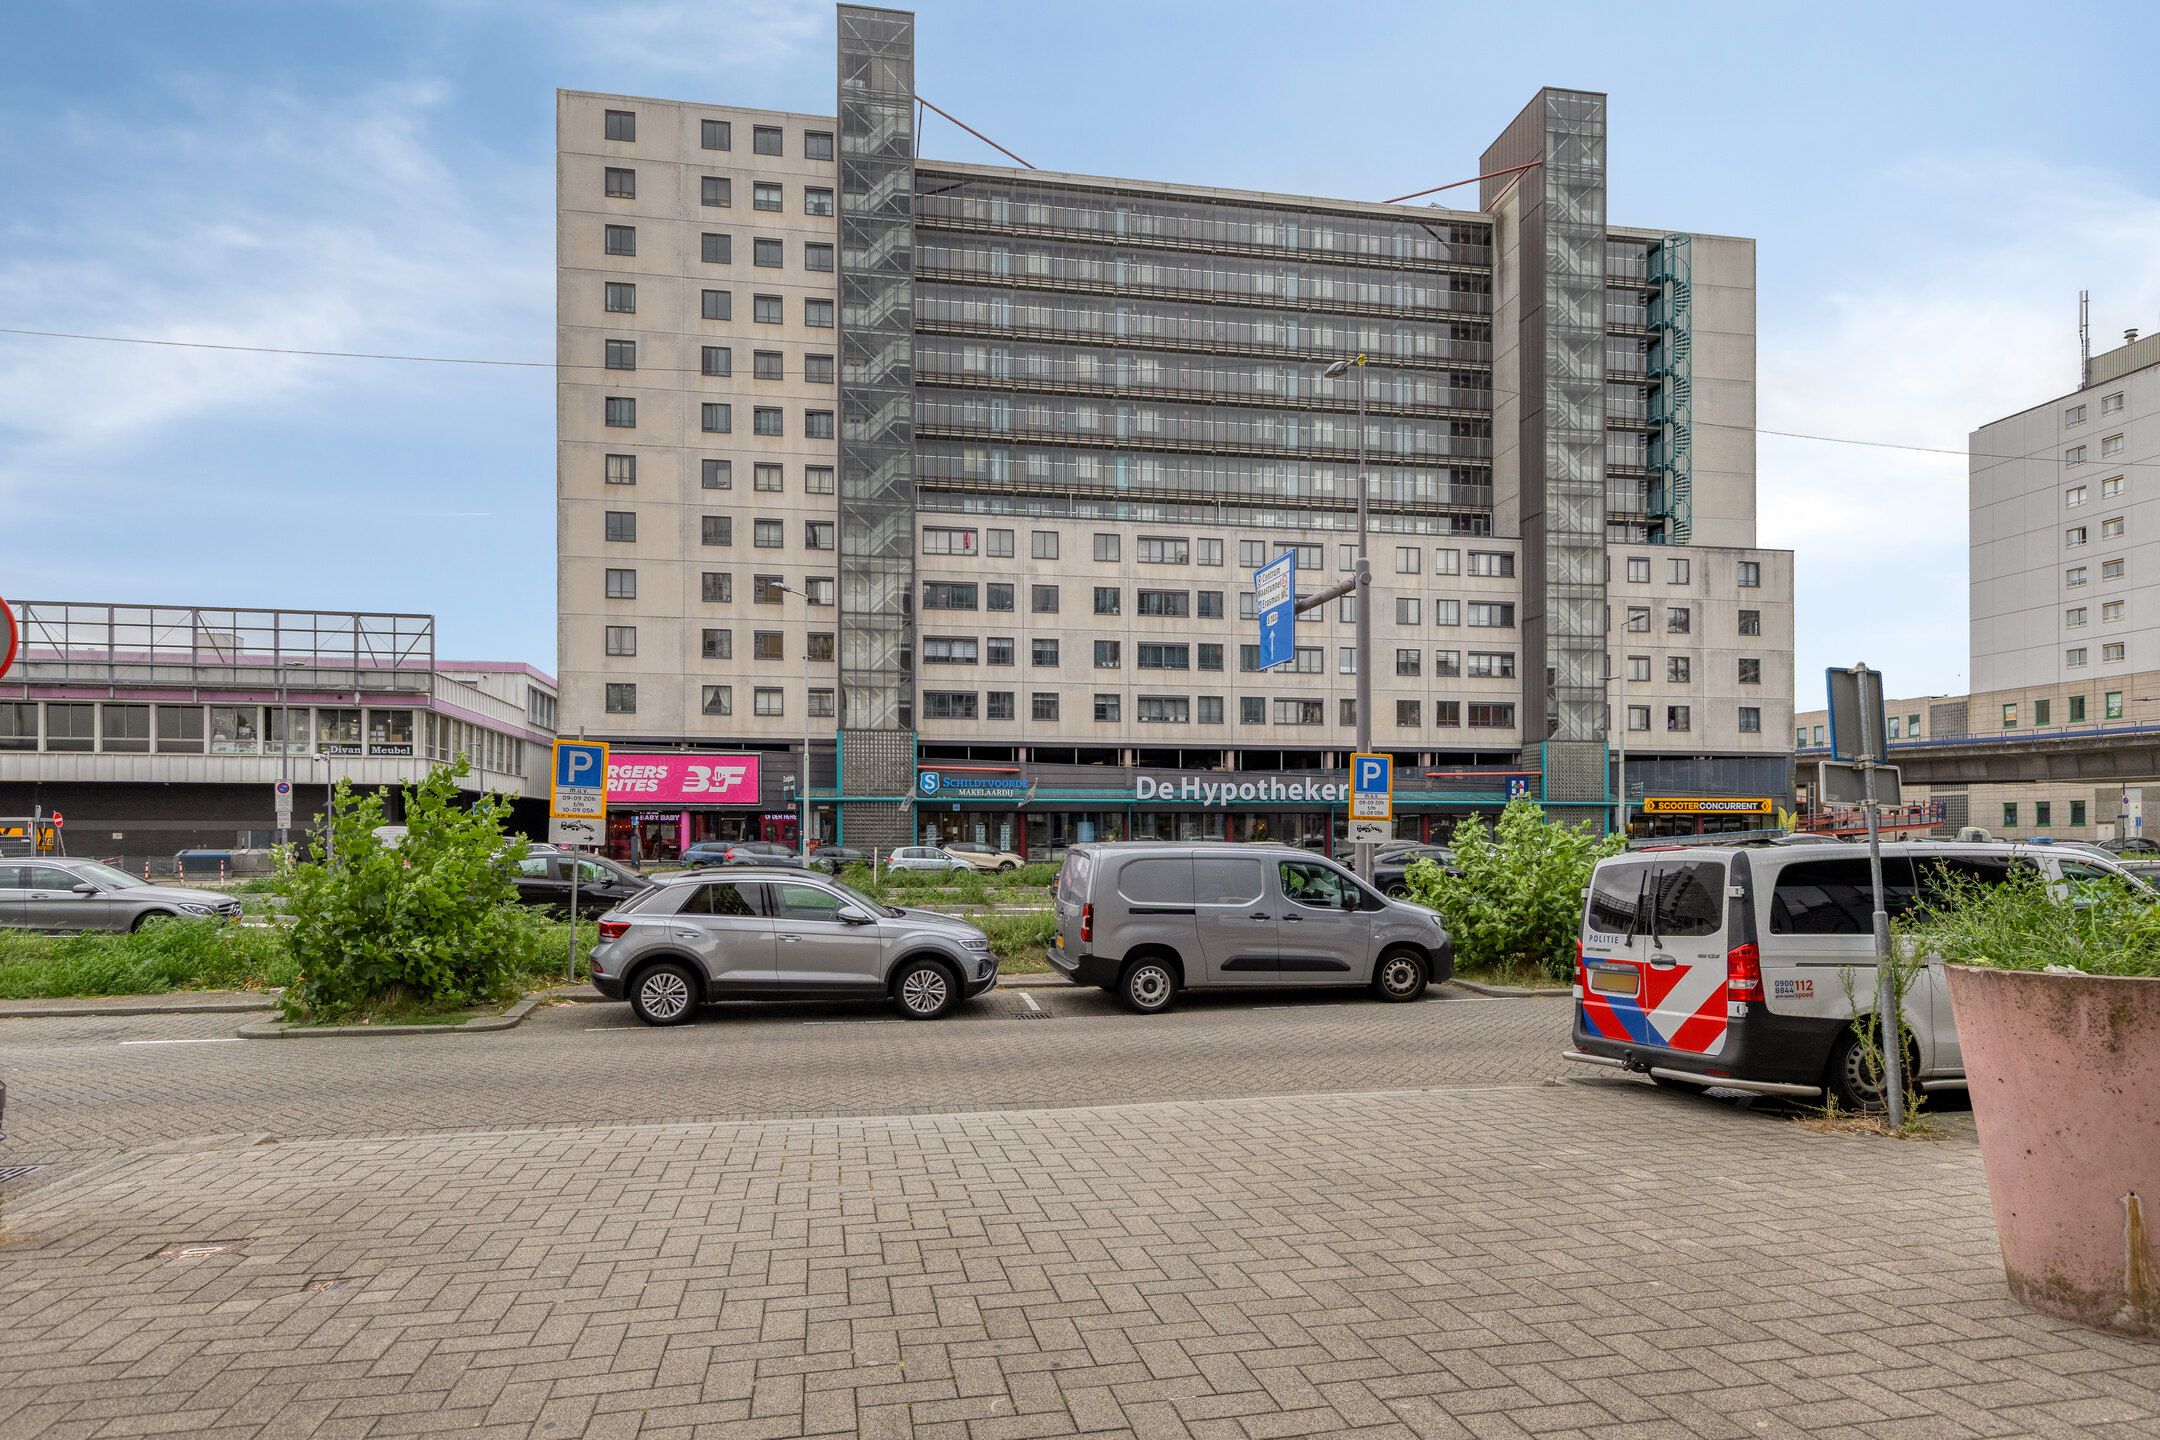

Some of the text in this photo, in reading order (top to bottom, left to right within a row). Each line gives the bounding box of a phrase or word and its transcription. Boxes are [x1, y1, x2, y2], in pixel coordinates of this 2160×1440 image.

[1262, 567, 1281, 583] Centrum
[1262, 594, 1280, 609] Erasmus
[330, 745, 410, 755] Divan Meubel
[568, 750, 593, 783] P
[607, 765, 668, 779] RGERS
[1362, 761, 1381, 789] P
[606, 778, 659, 792] RITES
[1136, 776, 1349, 807] De Hypotheker
[958, 788, 1014, 797] MAKELAARDIJ
[1658, 801, 1758, 810] SCOOTERCONCURRENT
[1588, 934, 1619, 944] POLITIE
[1794, 979, 1813, 991] 112
